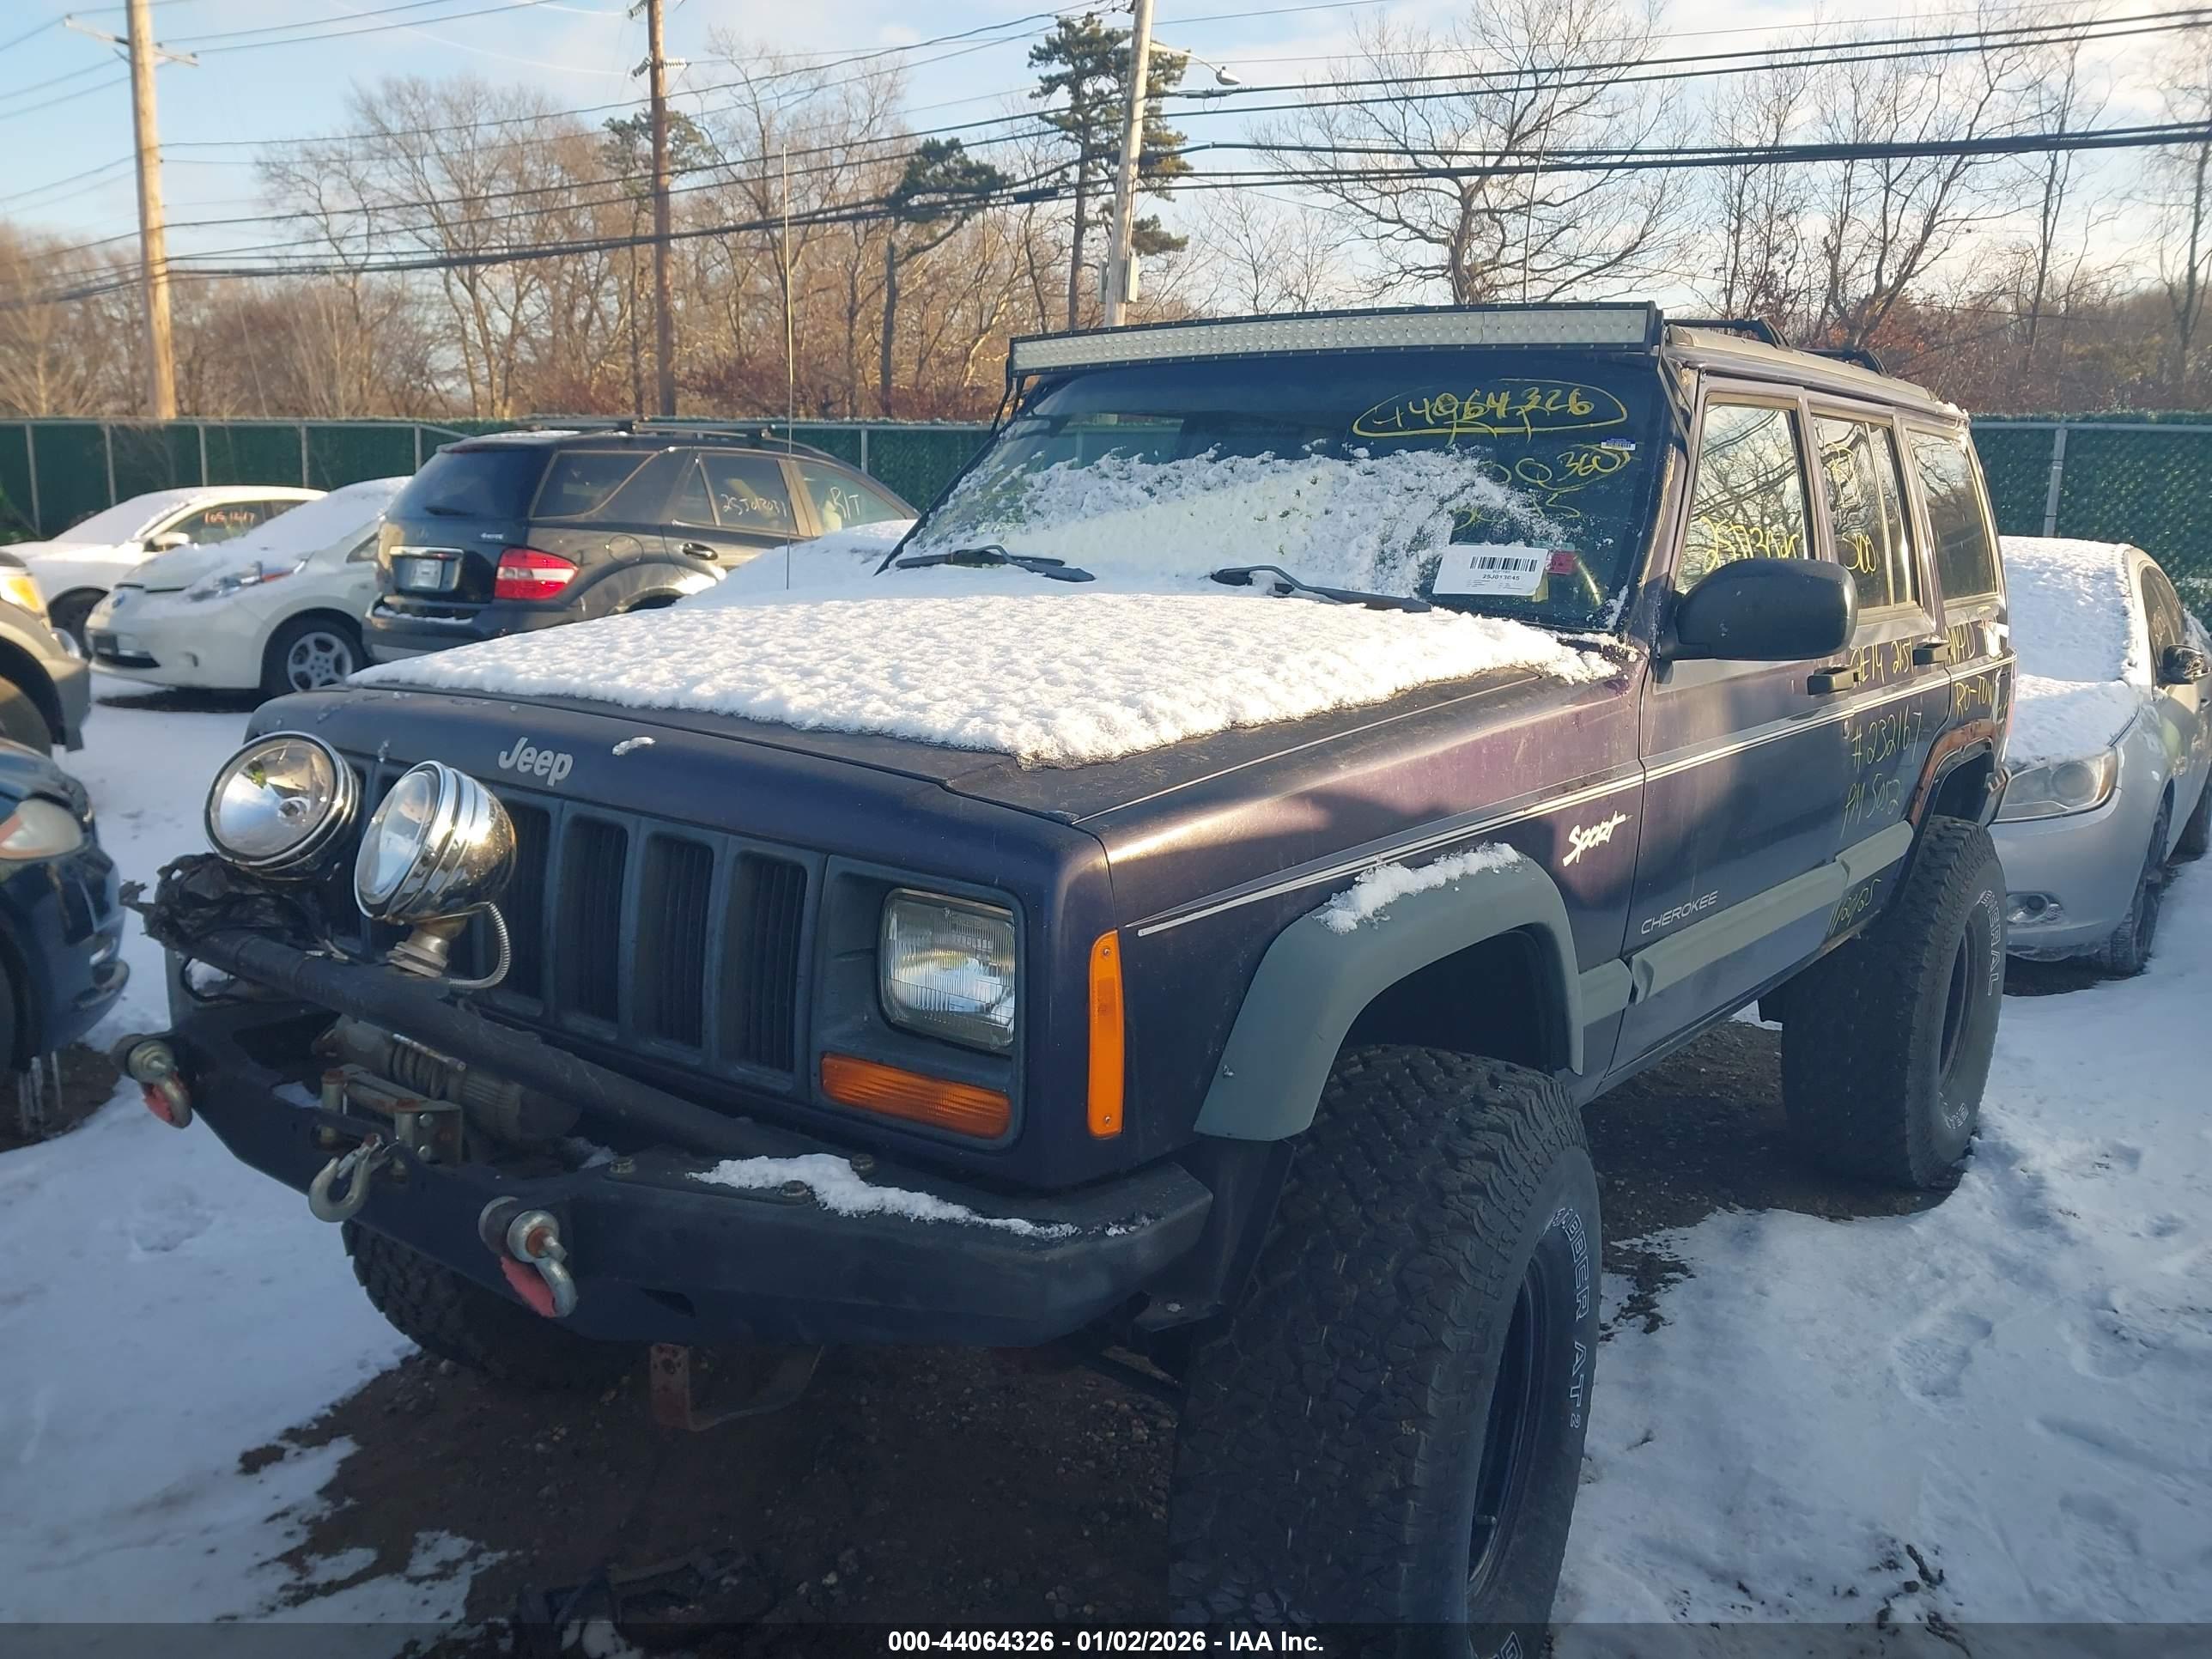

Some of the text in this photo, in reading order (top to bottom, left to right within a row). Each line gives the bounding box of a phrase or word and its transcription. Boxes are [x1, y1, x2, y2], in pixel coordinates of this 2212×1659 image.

[498, 737, 574, 787] Jeep
[1641, 890, 1718, 934] CHEROKEE
[1980, 890, 2001, 996] ENERAL
[1553, 1207, 1589, 1323] BBER
